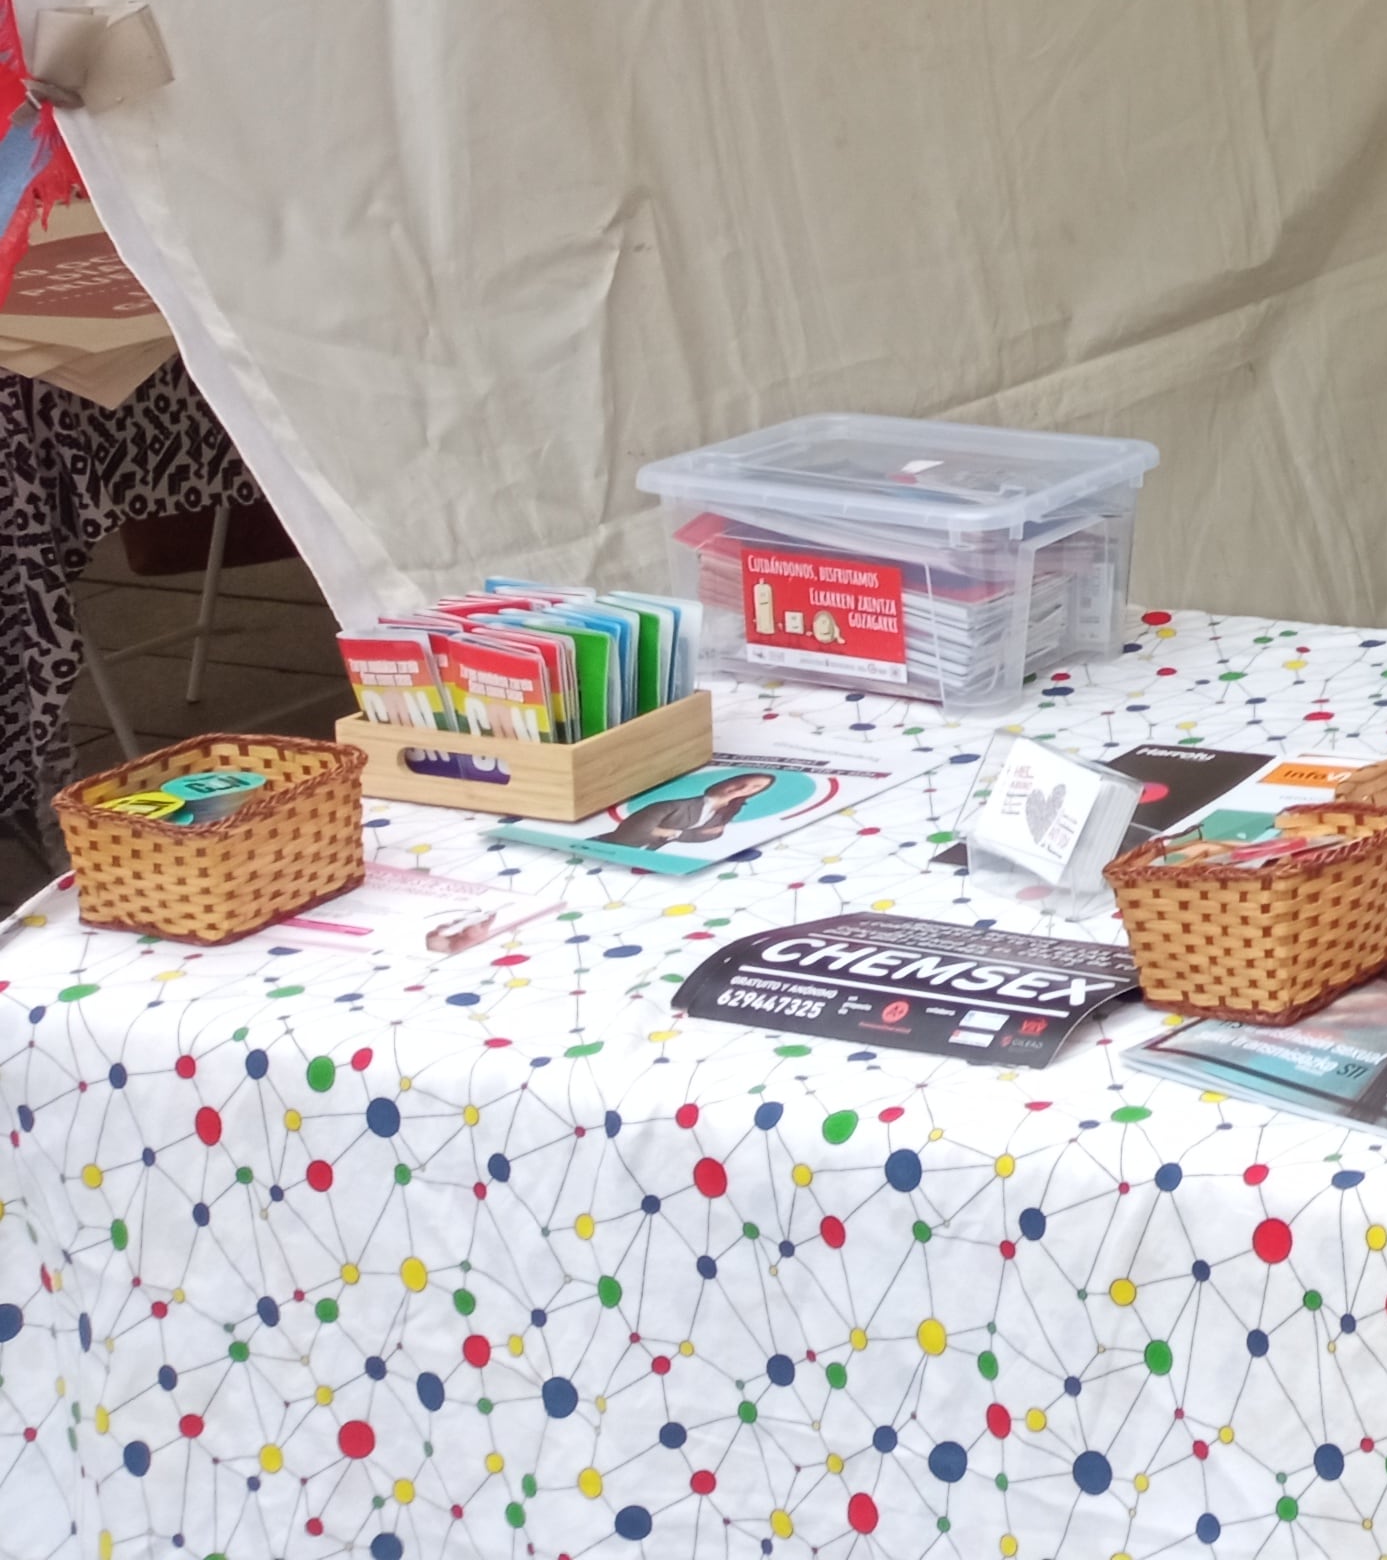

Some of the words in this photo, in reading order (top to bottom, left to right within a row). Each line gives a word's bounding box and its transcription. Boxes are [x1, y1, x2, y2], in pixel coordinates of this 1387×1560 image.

[730, 974, 781, 992] GRATUITO
[761, 938, 1117, 1007] CHEMSEX
[716, 988, 827, 1020] 629447325
